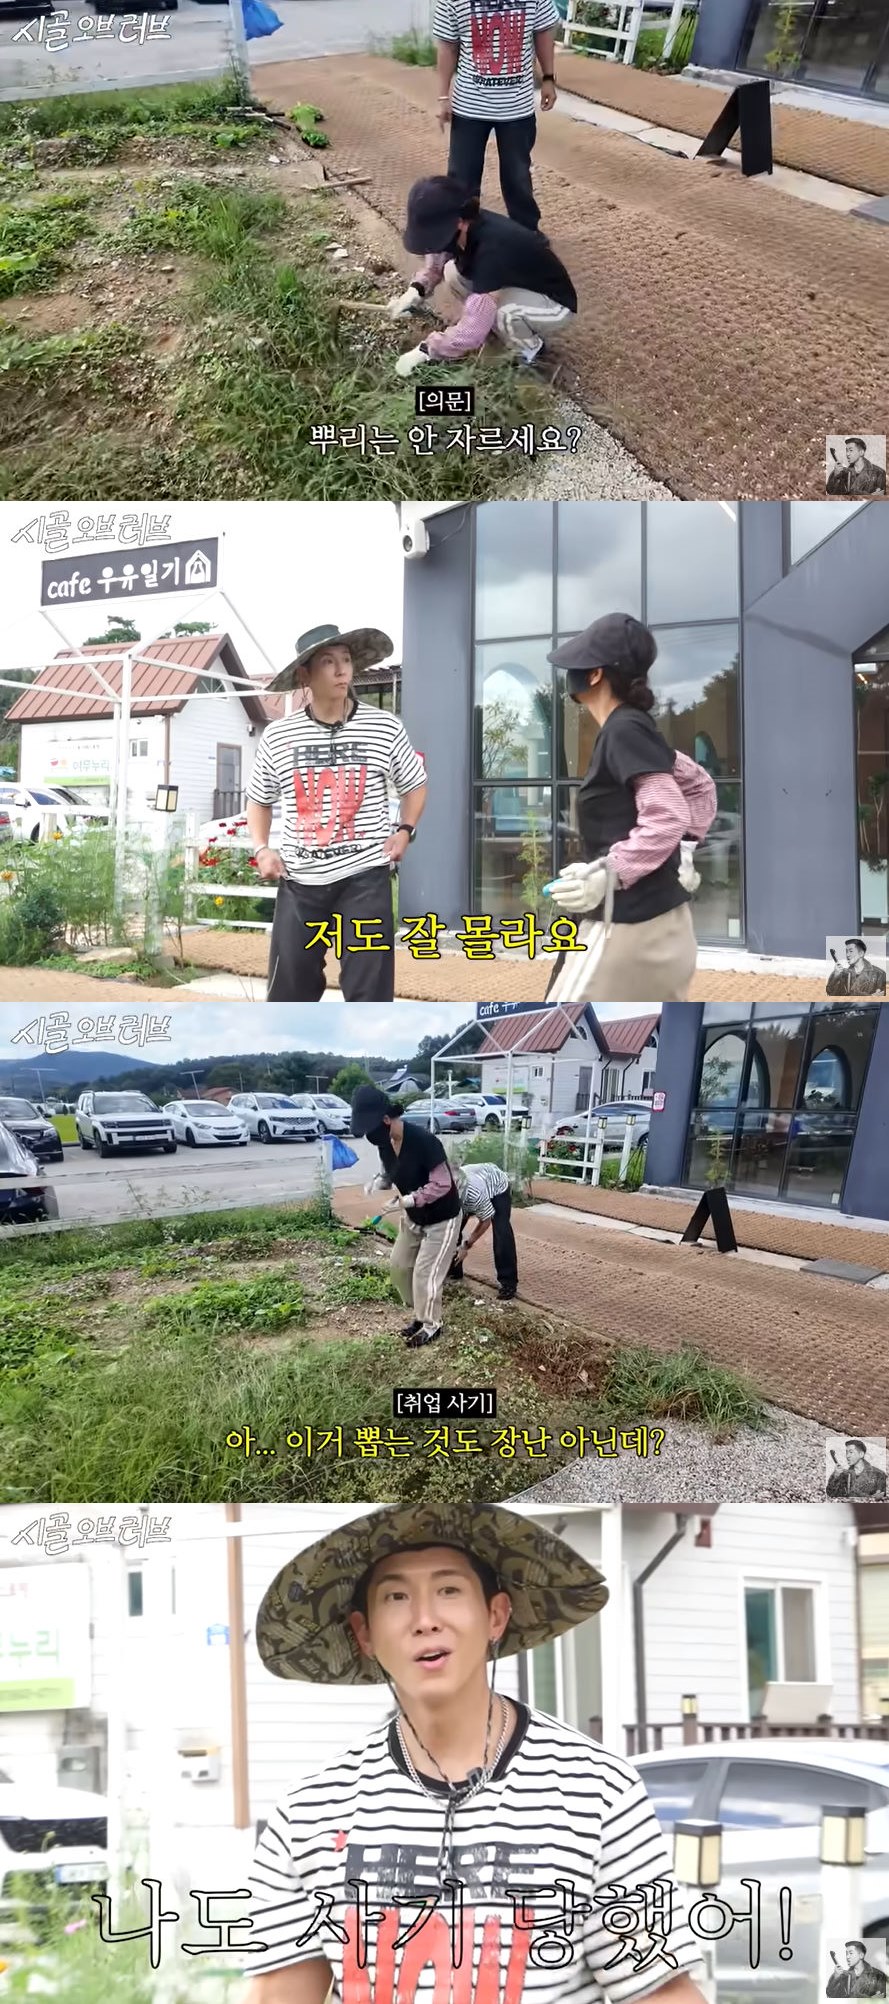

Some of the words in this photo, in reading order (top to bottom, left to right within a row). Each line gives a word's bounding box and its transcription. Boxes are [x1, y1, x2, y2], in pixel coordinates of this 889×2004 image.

[47, 571, 92, 599] cafe
[97, 557, 180, 594] 우유일기
[479, 1004, 500, 1016] cafe
